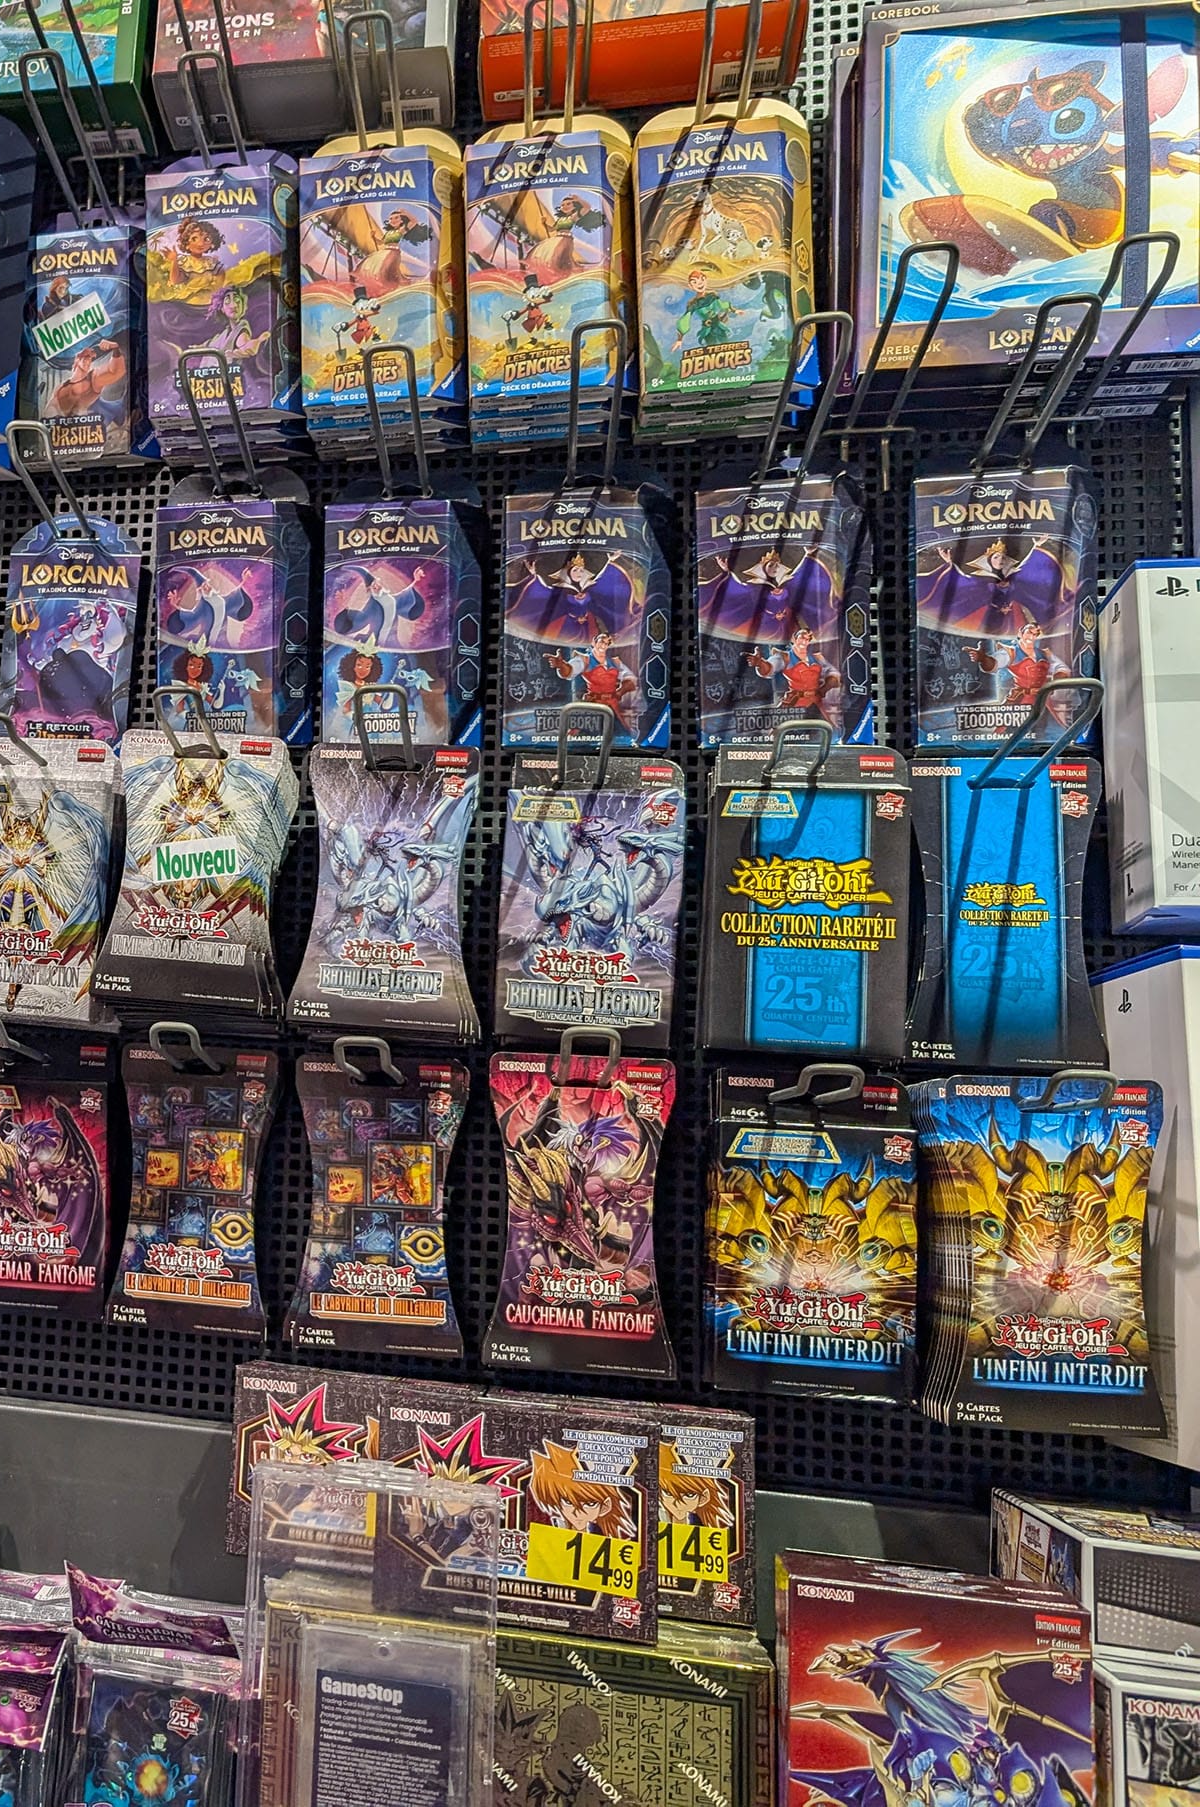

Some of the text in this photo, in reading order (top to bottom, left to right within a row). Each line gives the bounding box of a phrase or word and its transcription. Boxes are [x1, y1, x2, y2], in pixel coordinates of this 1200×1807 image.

[871, 4, 941, 20] LOREBOOK
[483, 154, 588, 185] LORCANA
[657, 141, 768, 174] LORCANA
[316, 167, 415, 200] LORCANA
[162, 187, 258, 215] LORCANA
[32, 248, 118, 274] LORCANA
[36, 301, 106, 355] Nouveau
[680, 350, 752, 379] D'ENCRES
[501, 383, 519, 392] DECK
[651, 374, 756, 388] 8+ DECK DÉMARRAGE
[711, 508, 824, 534] LORCANA
[932, 500, 1056, 528] LORCANA
[169, 525, 267, 552] LORCANA
[339, 525, 439, 551] LORCANA
[520, 516, 627, 539] LORCANA
[21, 564, 129, 590] LORCANA
[45, 722, 90, 733] RETOUR
[956, 711, 1031, 727] FLOODBORN
[321, 750, 362, 760] KONAMI
[911, 766, 962, 777] KONAMI
[156, 845, 237, 880] Nouveau
[751, 868, 868, 894] Yu-Gi-Oh!
[721, 912, 897, 939] COLLECTION RARETÉ II
[737, 936, 880, 951] DU ANNIVERSAIRE
[912, 1042, 918, 1050] 9
[500, 1061, 546, 1073] KONAMI
[955, 1085, 1011, 1097] KONAMI
[188, 1280, 199, 1294] DU
[506, 1303, 585, 1326] CAUCHEMAR
[727, 1331, 905, 1362] L'INFINI INTERDIT
[1012, 1326, 1111, 1348] Yu-Gi-Oh!
[243, 1376, 297, 1394] KONAMI
[974, 1358, 1148, 1388] L'INFINI INTERDIT
[797, 1584, 855, 1602] KONAMI
[320, 1676, 404, 1706] GameStop
[668, 1657, 729, 1699] KONAMI
